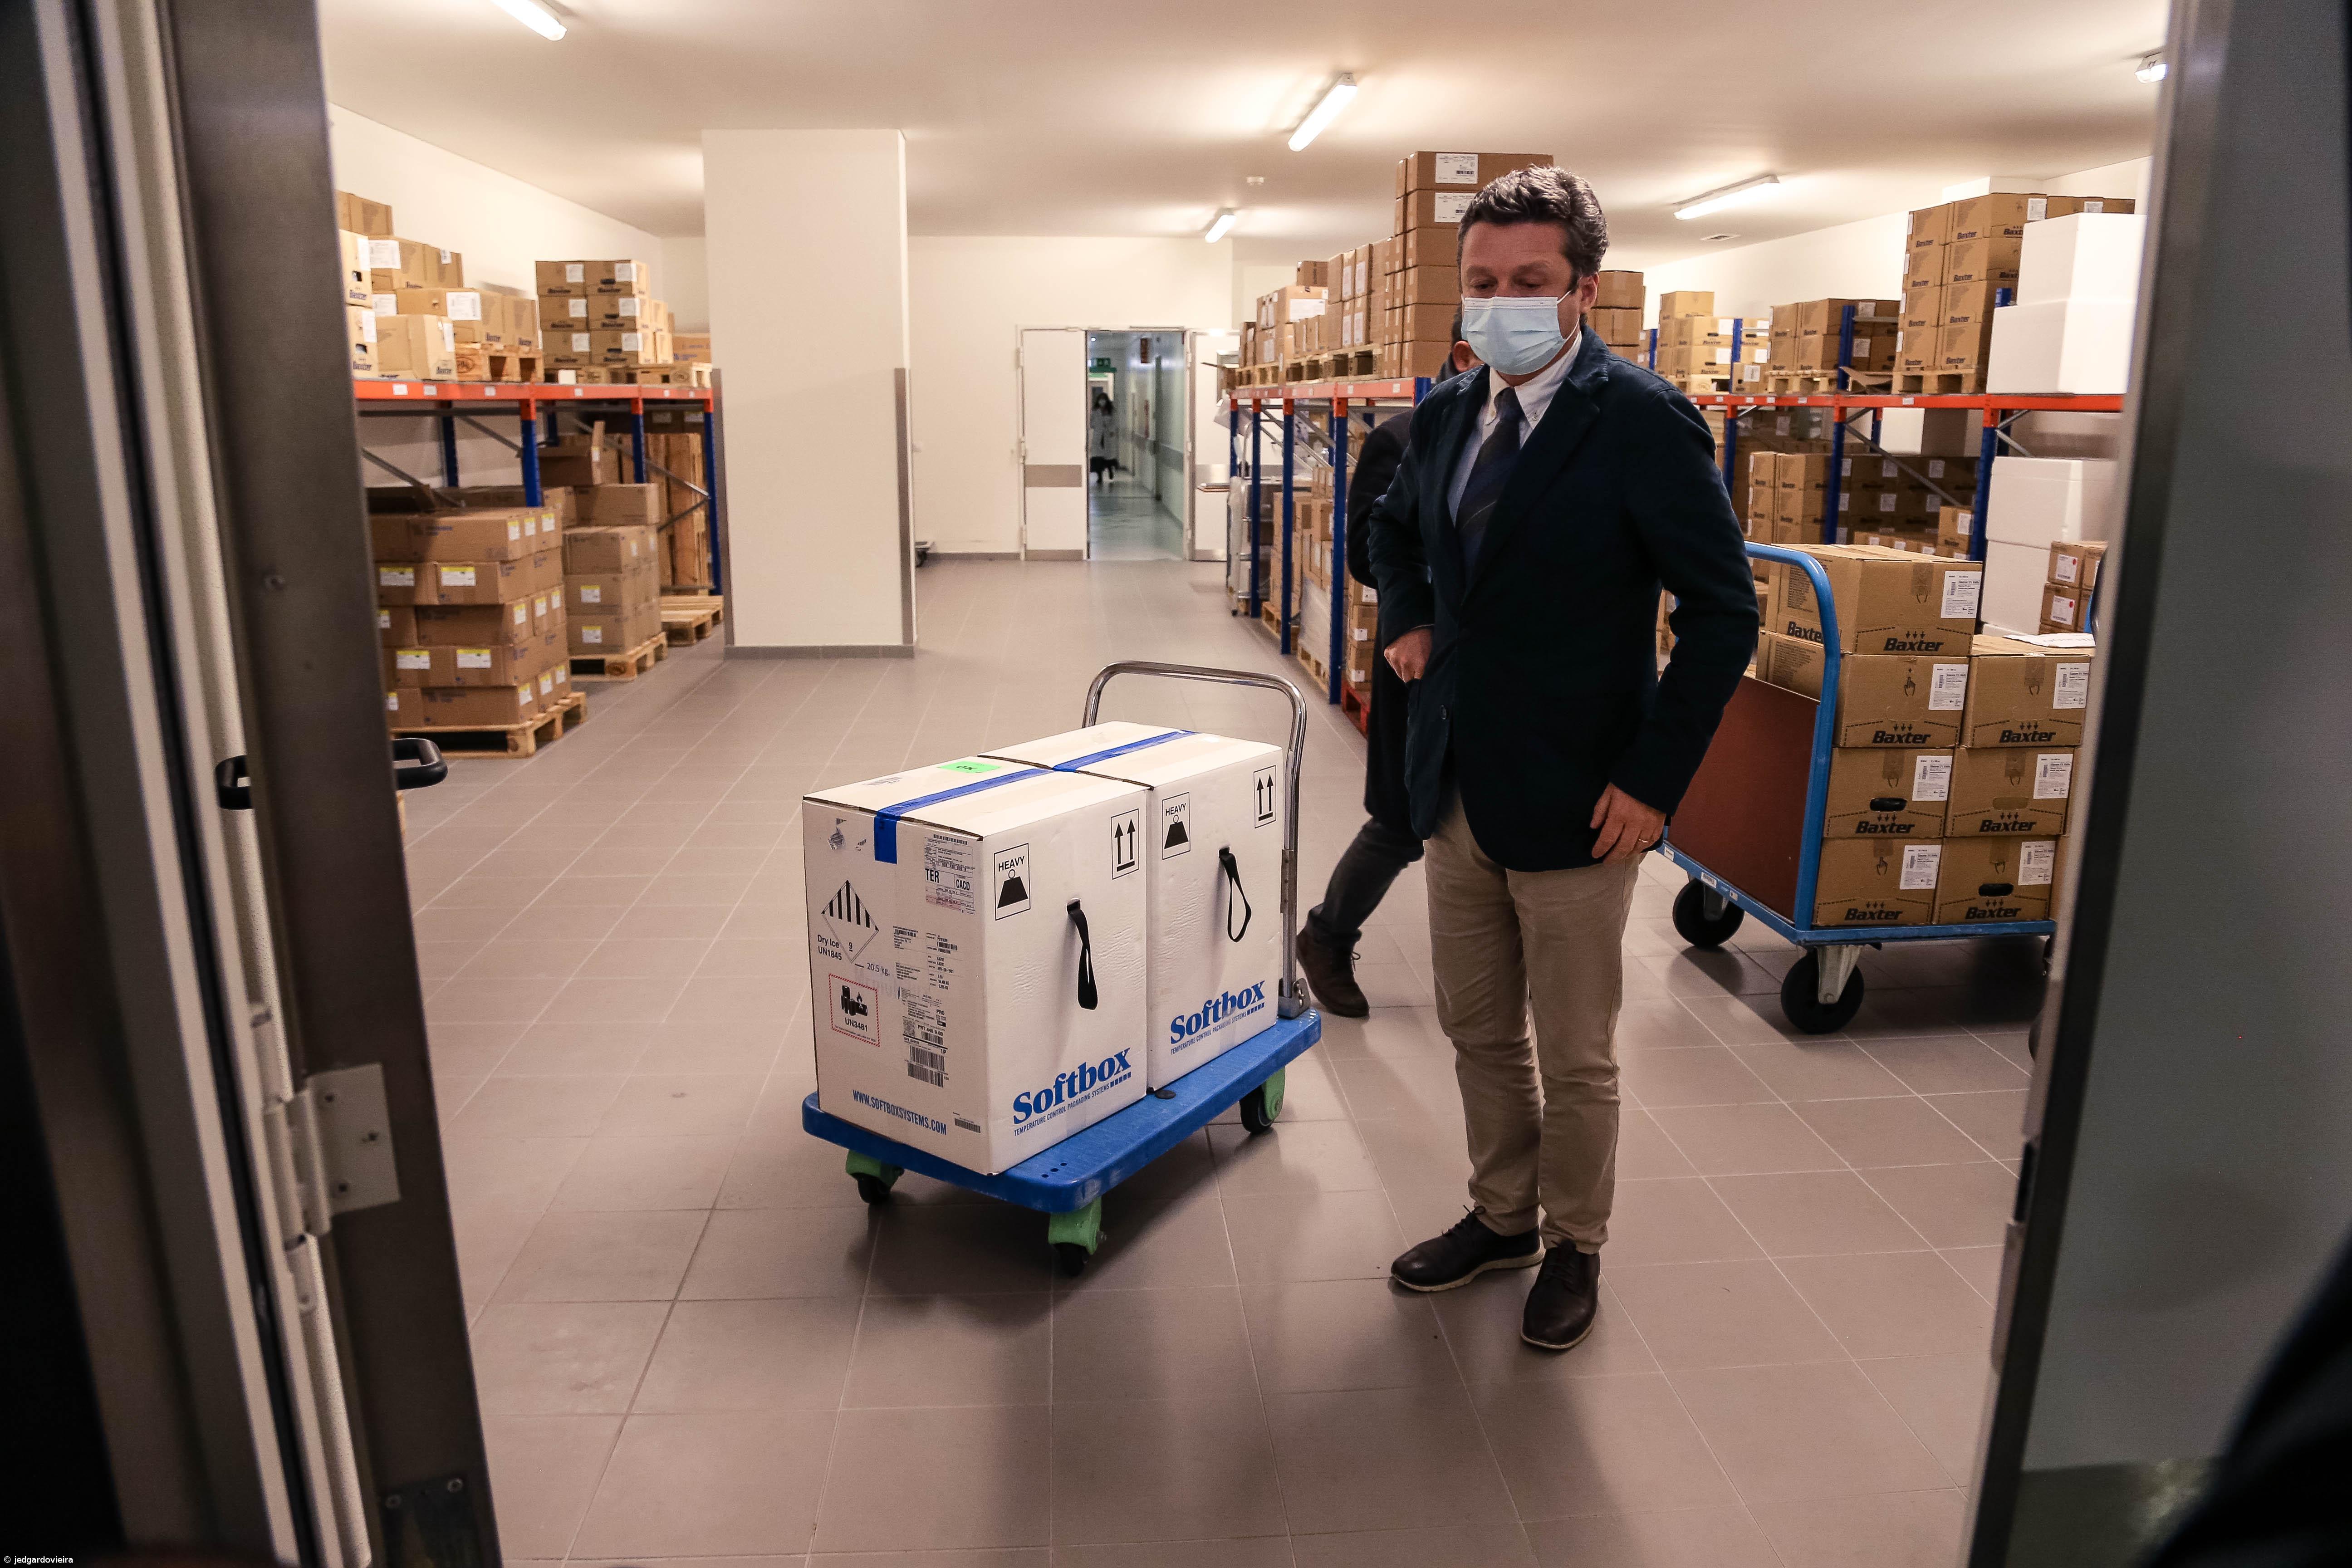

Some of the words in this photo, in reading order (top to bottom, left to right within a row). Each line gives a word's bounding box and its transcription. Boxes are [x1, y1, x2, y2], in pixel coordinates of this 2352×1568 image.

[1787, 621, 1824, 644] Baxte
[1883, 637, 1944, 652] Baxter
[1872, 730, 1931, 744] Baxter
[1999, 729, 2056, 743] Baxter
[1165, 803, 1187, 816] HEAVY
[1855, 821, 1916, 834] Baxter
[1979, 819, 2037, 833] Baxter
[998, 856, 1025, 872] HEAVY
[925, 868, 939, 883] TER
[1844, 908, 1903, 921] Baxter
[1965, 907, 2022, 920] Baxter
[817, 935, 828, 946] Dry
[830, 939, 839, 948] Ice
[818, 946, 842, 960] UN1845
[867, 962, 880, 972] 20.5
[1171, 980, 1265, 1044] Softbox
[845, 1017, 867, 1032] UN3481
[1171, 1038, 1196, 1055] TEMPERATURE
[1196, 1031, 1211, 1042] CONTROL
[1231, 1011, 1247, 1023] SYSTEMS
[1013, 1047, 1131, 1124] Softbox
[853, 1089, 947, 1135] WWW.SOFTBOXSYSTEMS.COM
[1014, 1116, 1046, 1136] TEMPERATURE
[1047, 1107, 1066, 1121] CONTROL
[1067, 1093, 1091, 1110] PACKAGING
[1092, 1083, 1110, 1098] SYSTEMS
